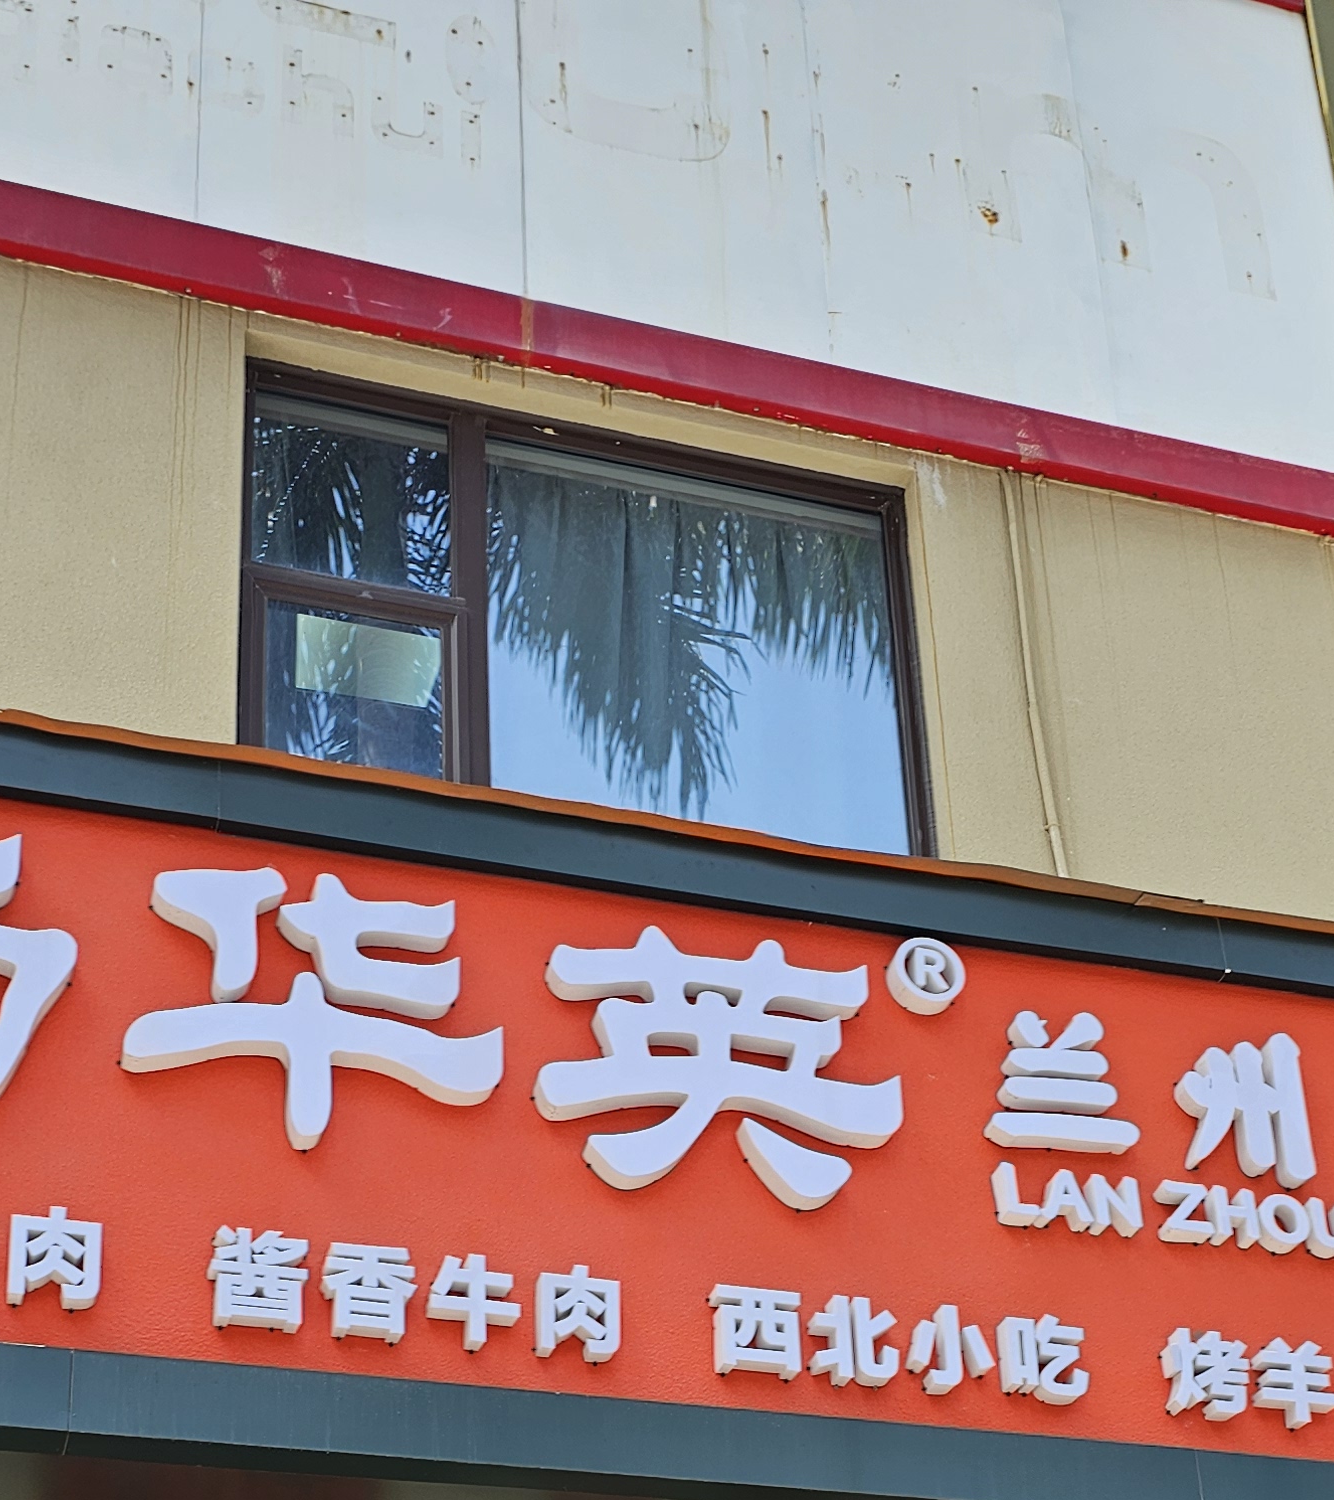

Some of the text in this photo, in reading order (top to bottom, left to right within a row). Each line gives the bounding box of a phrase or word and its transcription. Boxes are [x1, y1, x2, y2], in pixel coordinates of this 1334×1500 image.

[991, 1161, 1143, 1238] LAN
[206, 1225, 621, 1363] 酱香牛肉
[708, 1284, 1090, 1405] 西北小吃
